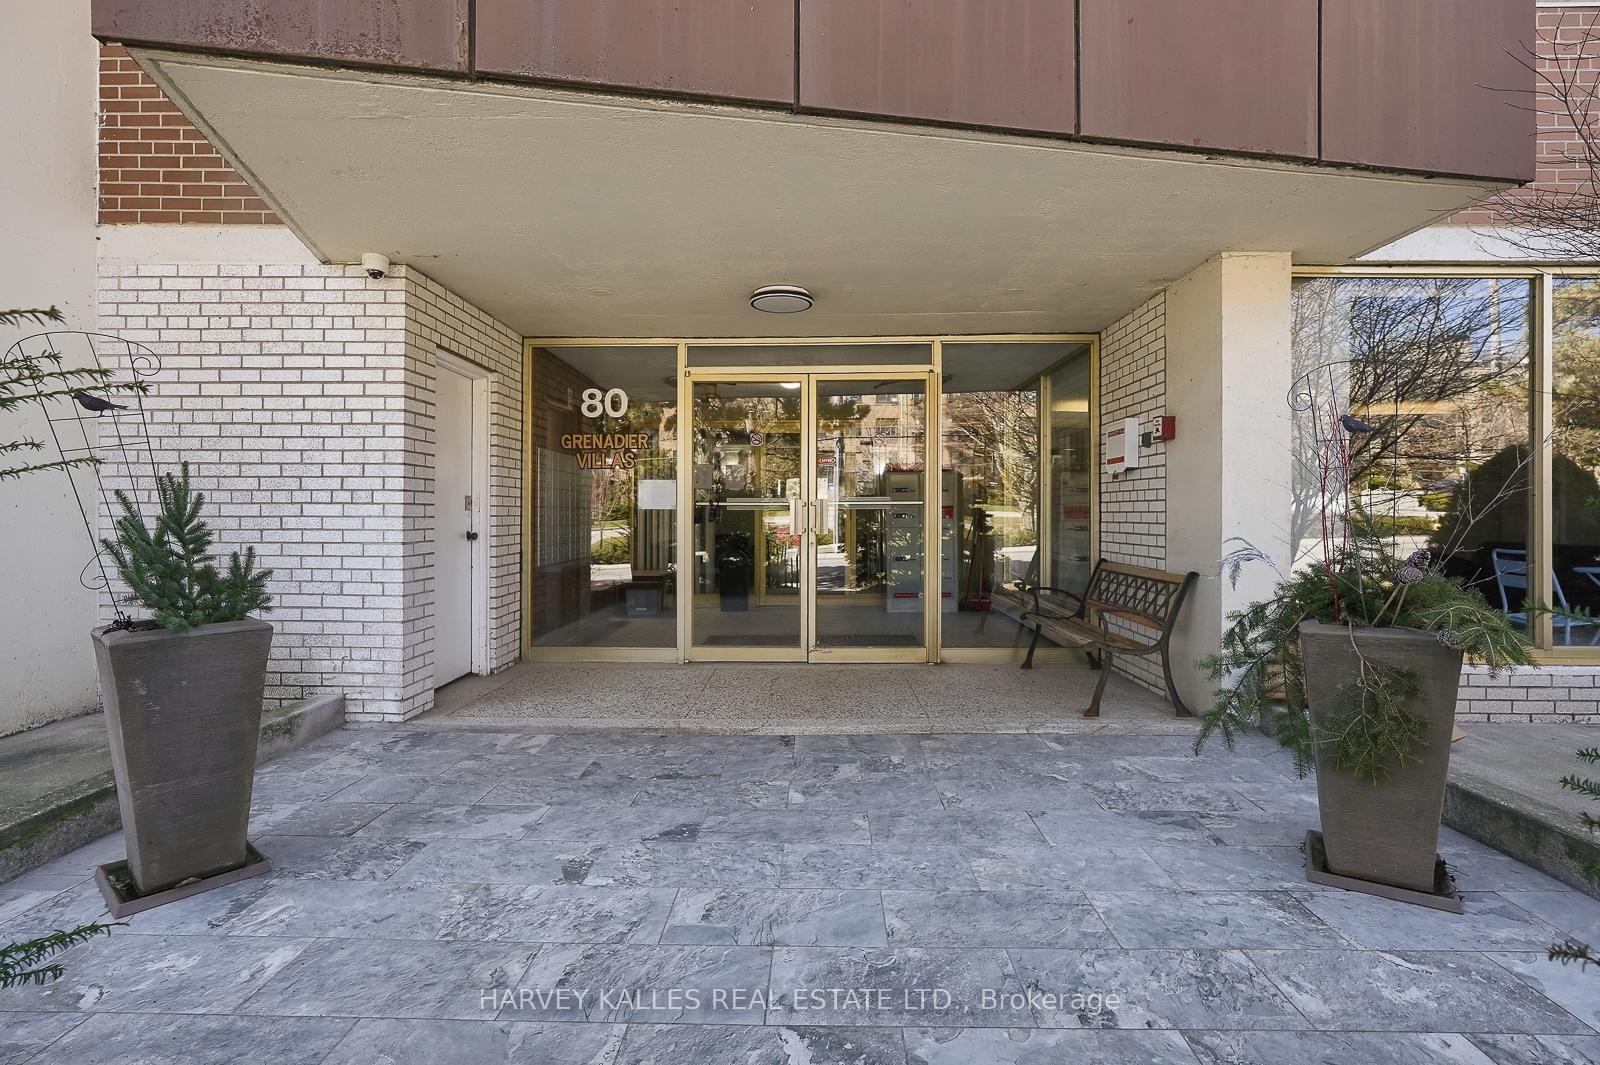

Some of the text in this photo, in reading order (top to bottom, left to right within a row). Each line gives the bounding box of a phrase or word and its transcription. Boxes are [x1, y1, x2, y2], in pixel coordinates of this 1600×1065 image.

[580, 388, 628, 418] 80
[561, 433, 650, 450] GRENADIER
[576, 452, 636, 470] VILLAS
